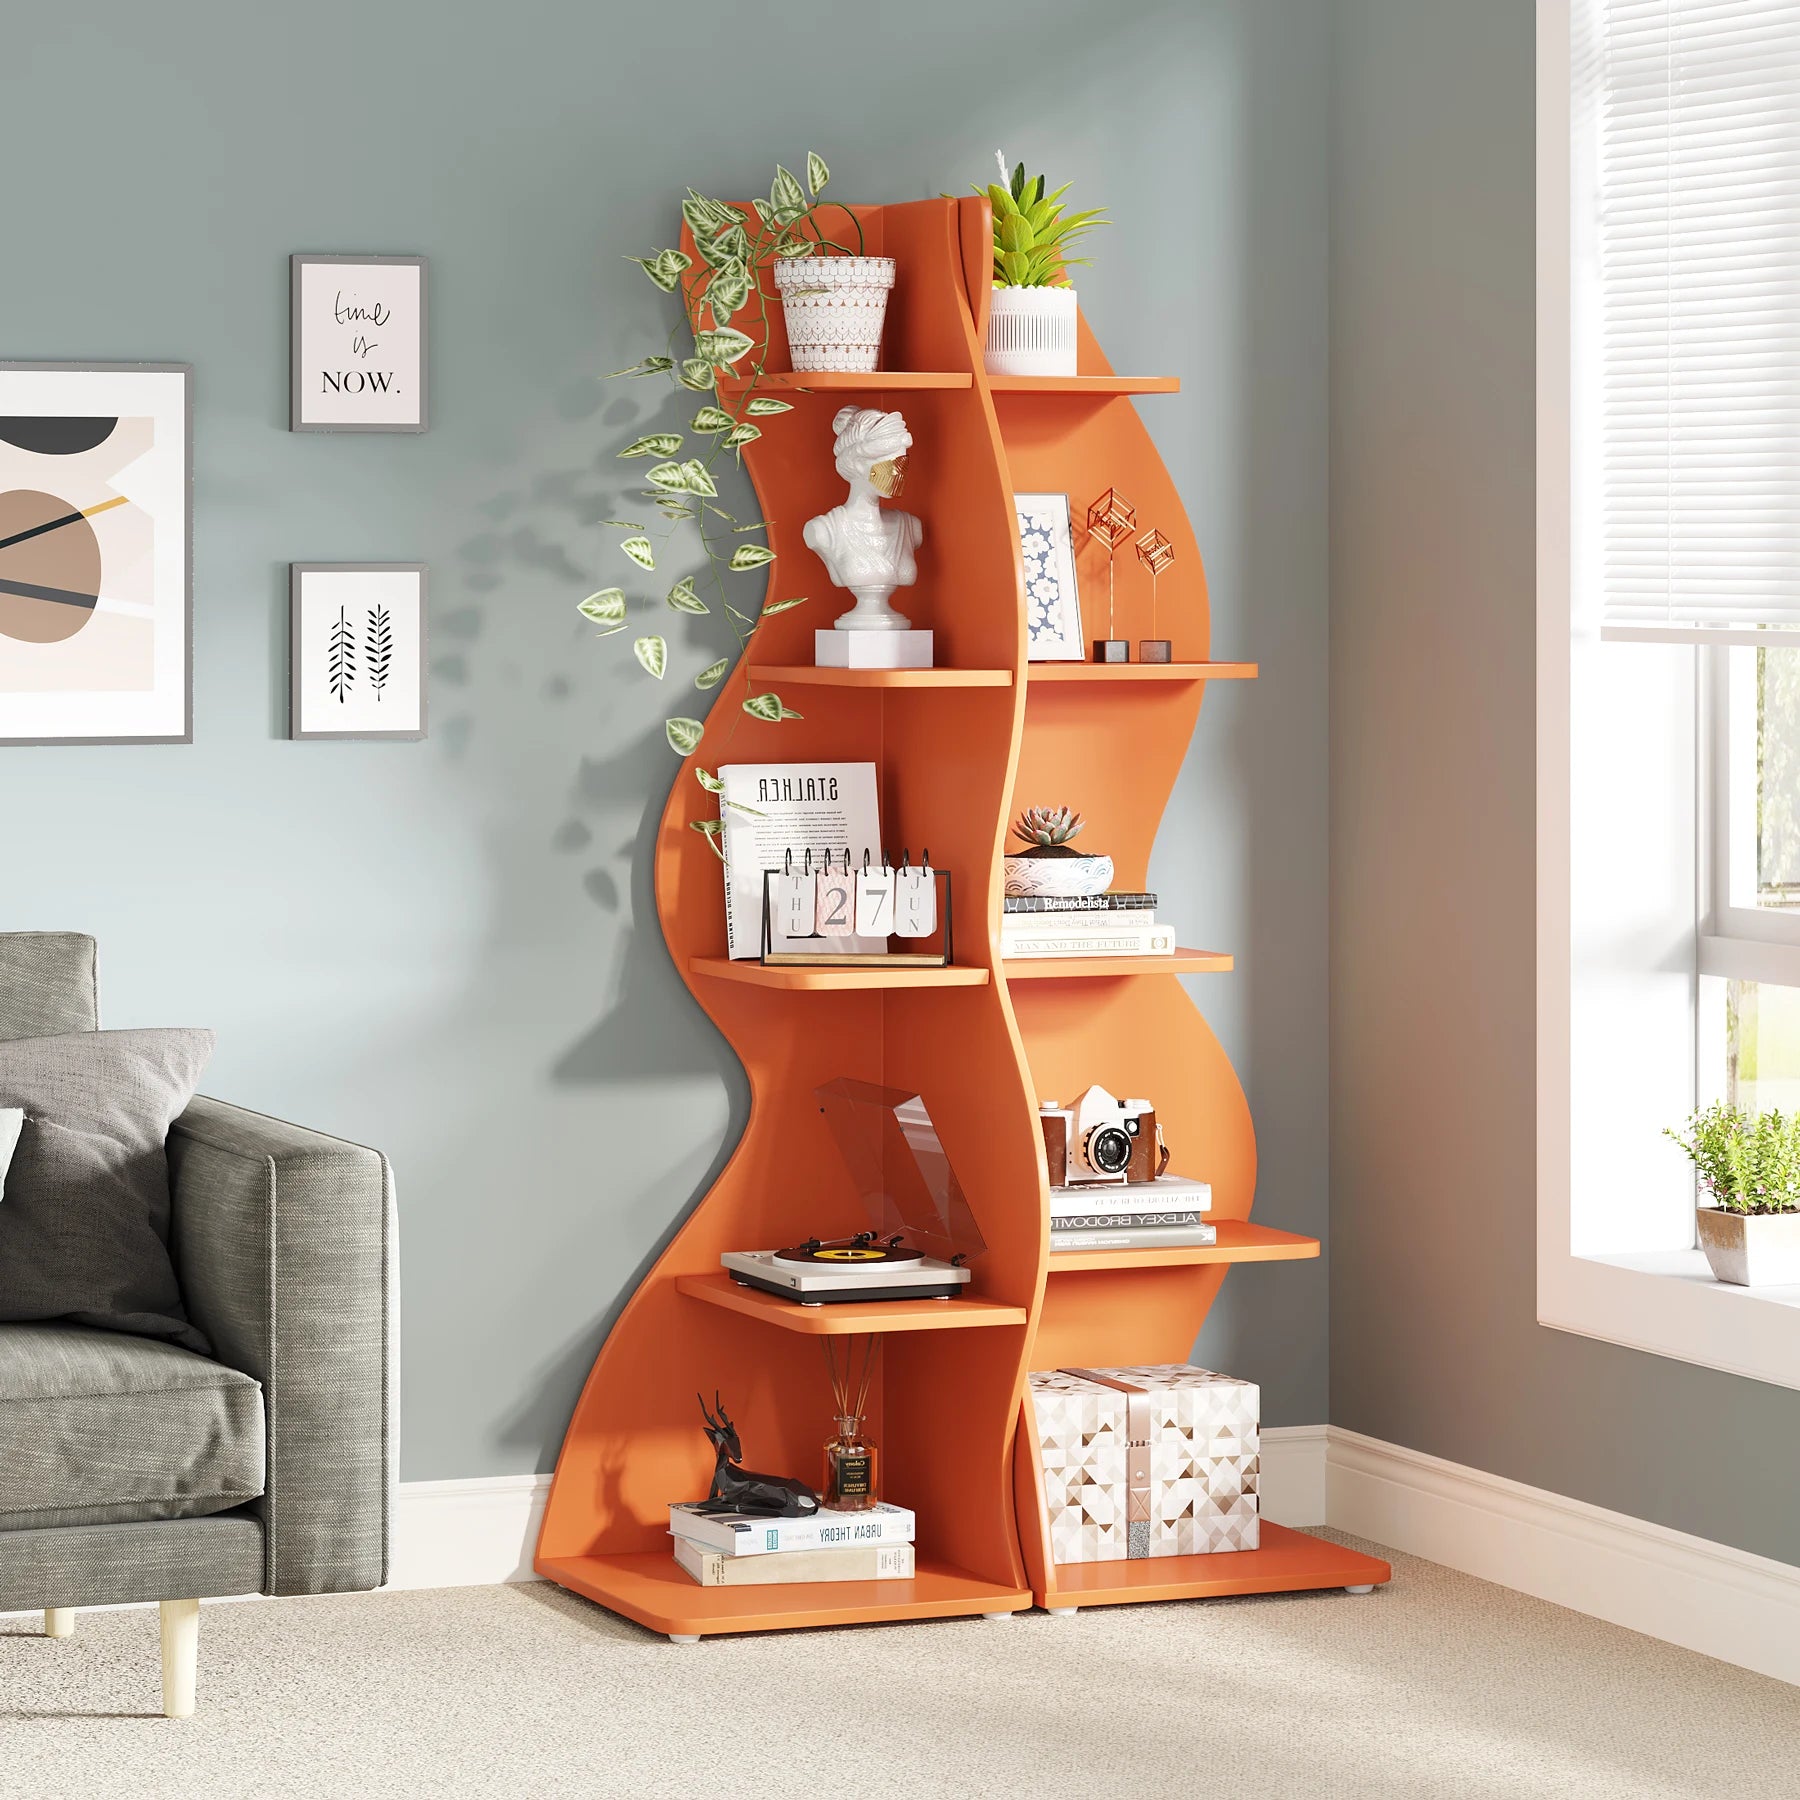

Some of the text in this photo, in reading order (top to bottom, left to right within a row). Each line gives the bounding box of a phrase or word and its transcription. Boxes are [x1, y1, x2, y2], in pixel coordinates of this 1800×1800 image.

[334, 290, 391, 327] time
[353, 330, 378, 359] is
[320, 371, 401, 394] NOW.
[791, 876, 803, 932] THU
[908, 875, 921, 932] JUN
[1044, 896, 1110, 911] Remodelista
[1071, 941, 1092, 949] THE
[1097, 939, 1141, 948] FUTURE
